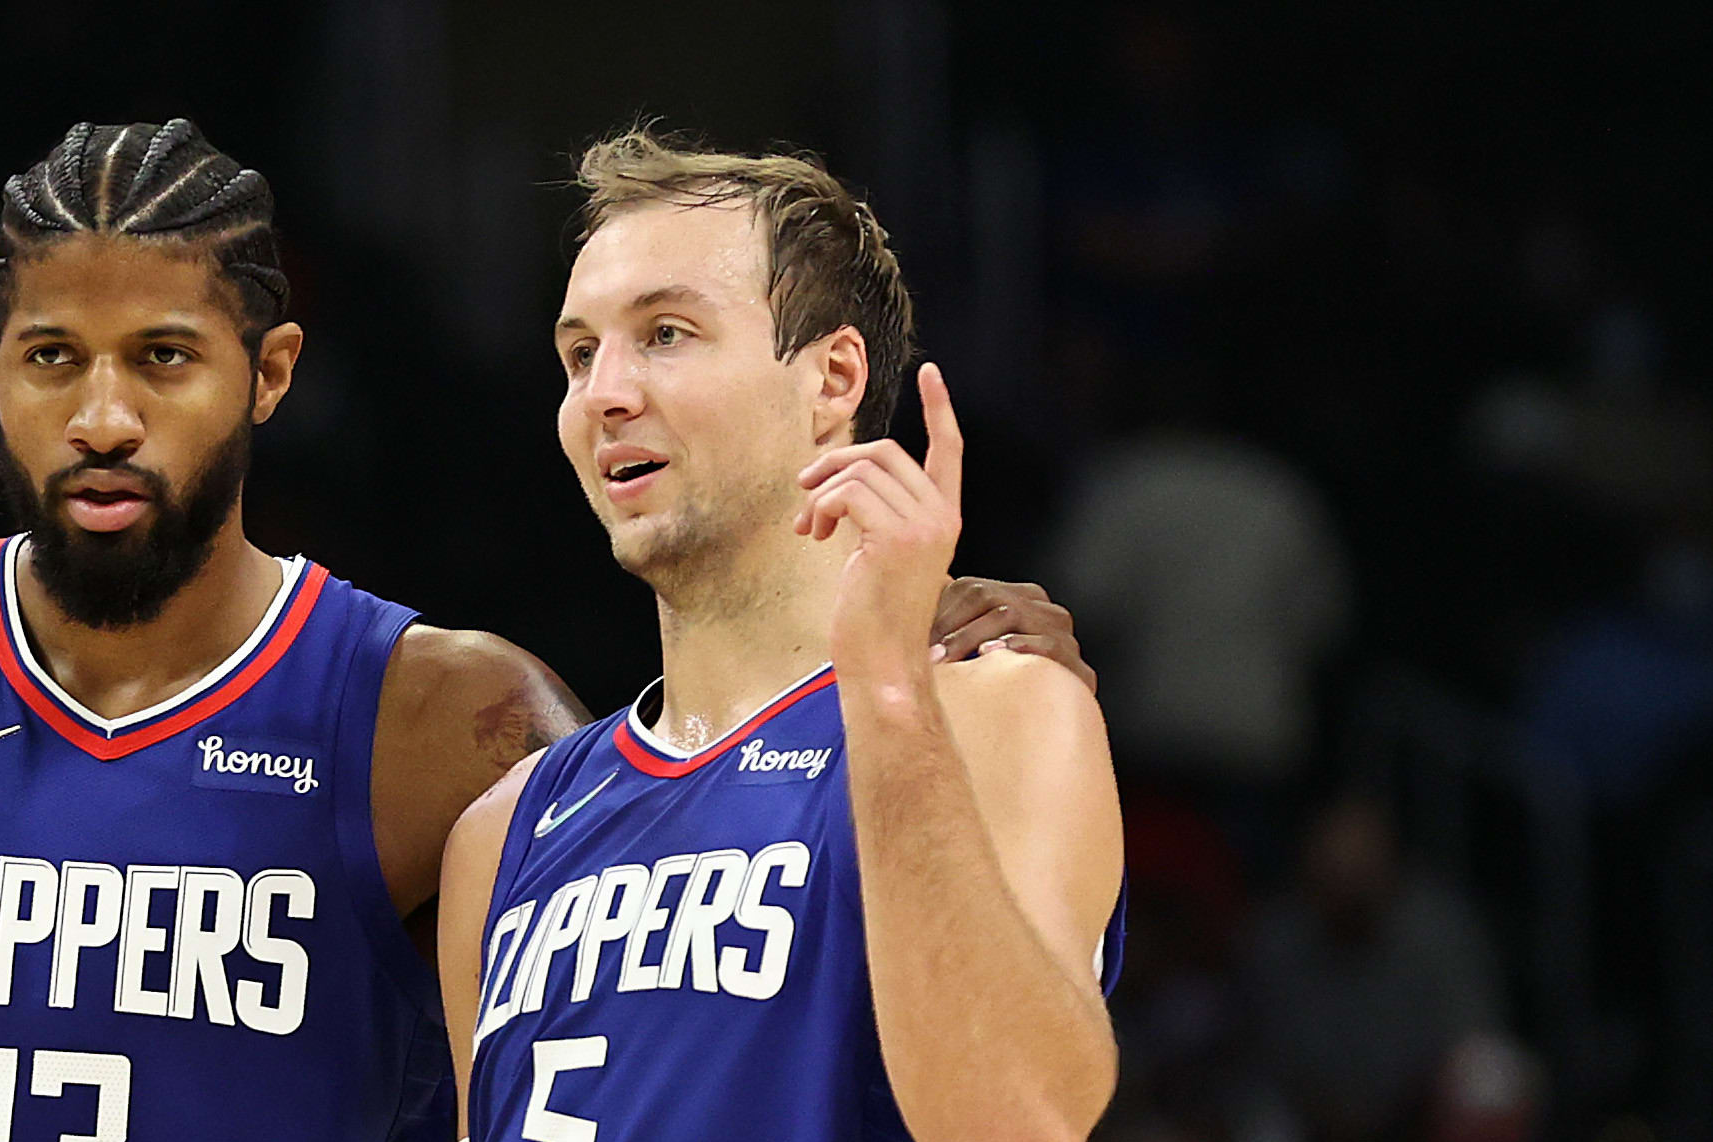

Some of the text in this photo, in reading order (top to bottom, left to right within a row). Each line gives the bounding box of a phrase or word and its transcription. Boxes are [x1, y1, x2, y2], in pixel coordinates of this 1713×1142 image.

[197, 734, 319, 794] honey
[738, 738, 832, 780] honey
[472, 841, 811, 1062] CLIPPERS
